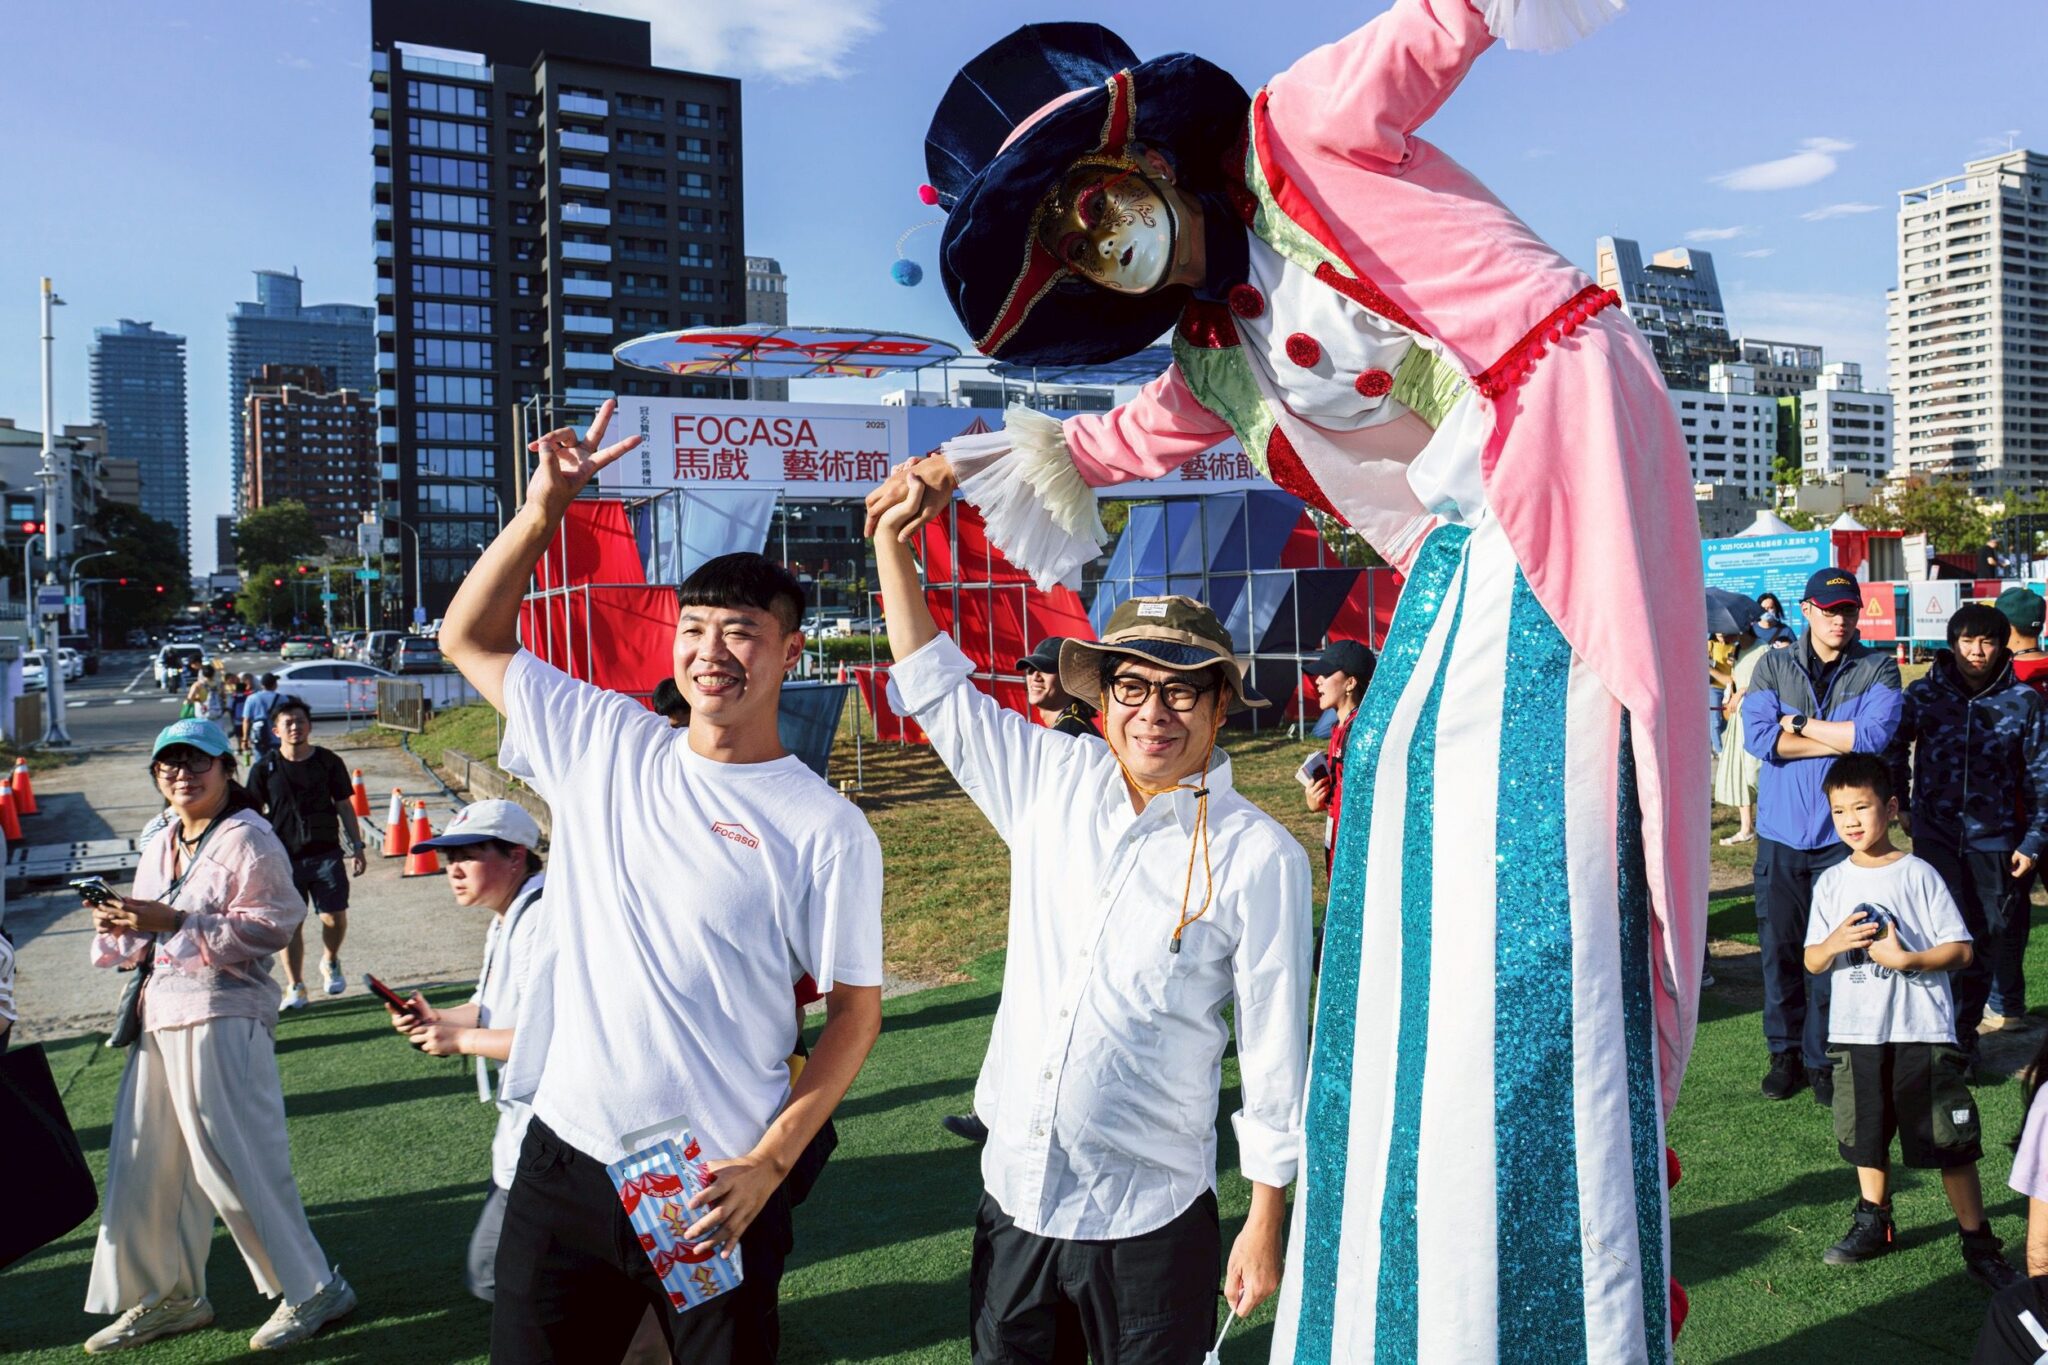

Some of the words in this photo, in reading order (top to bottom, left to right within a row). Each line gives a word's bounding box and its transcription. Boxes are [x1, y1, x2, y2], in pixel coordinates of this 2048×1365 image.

[673, 415, 818, 447] FOCASA
[865, 420, 886, 429] 2025
[673, 447, 749, 480] 馬戲
[783, 449, 889, 482] 藝術節
[648, 1187, 663, 1198] Pop
[663, 1186, 682, 1197] Corn
